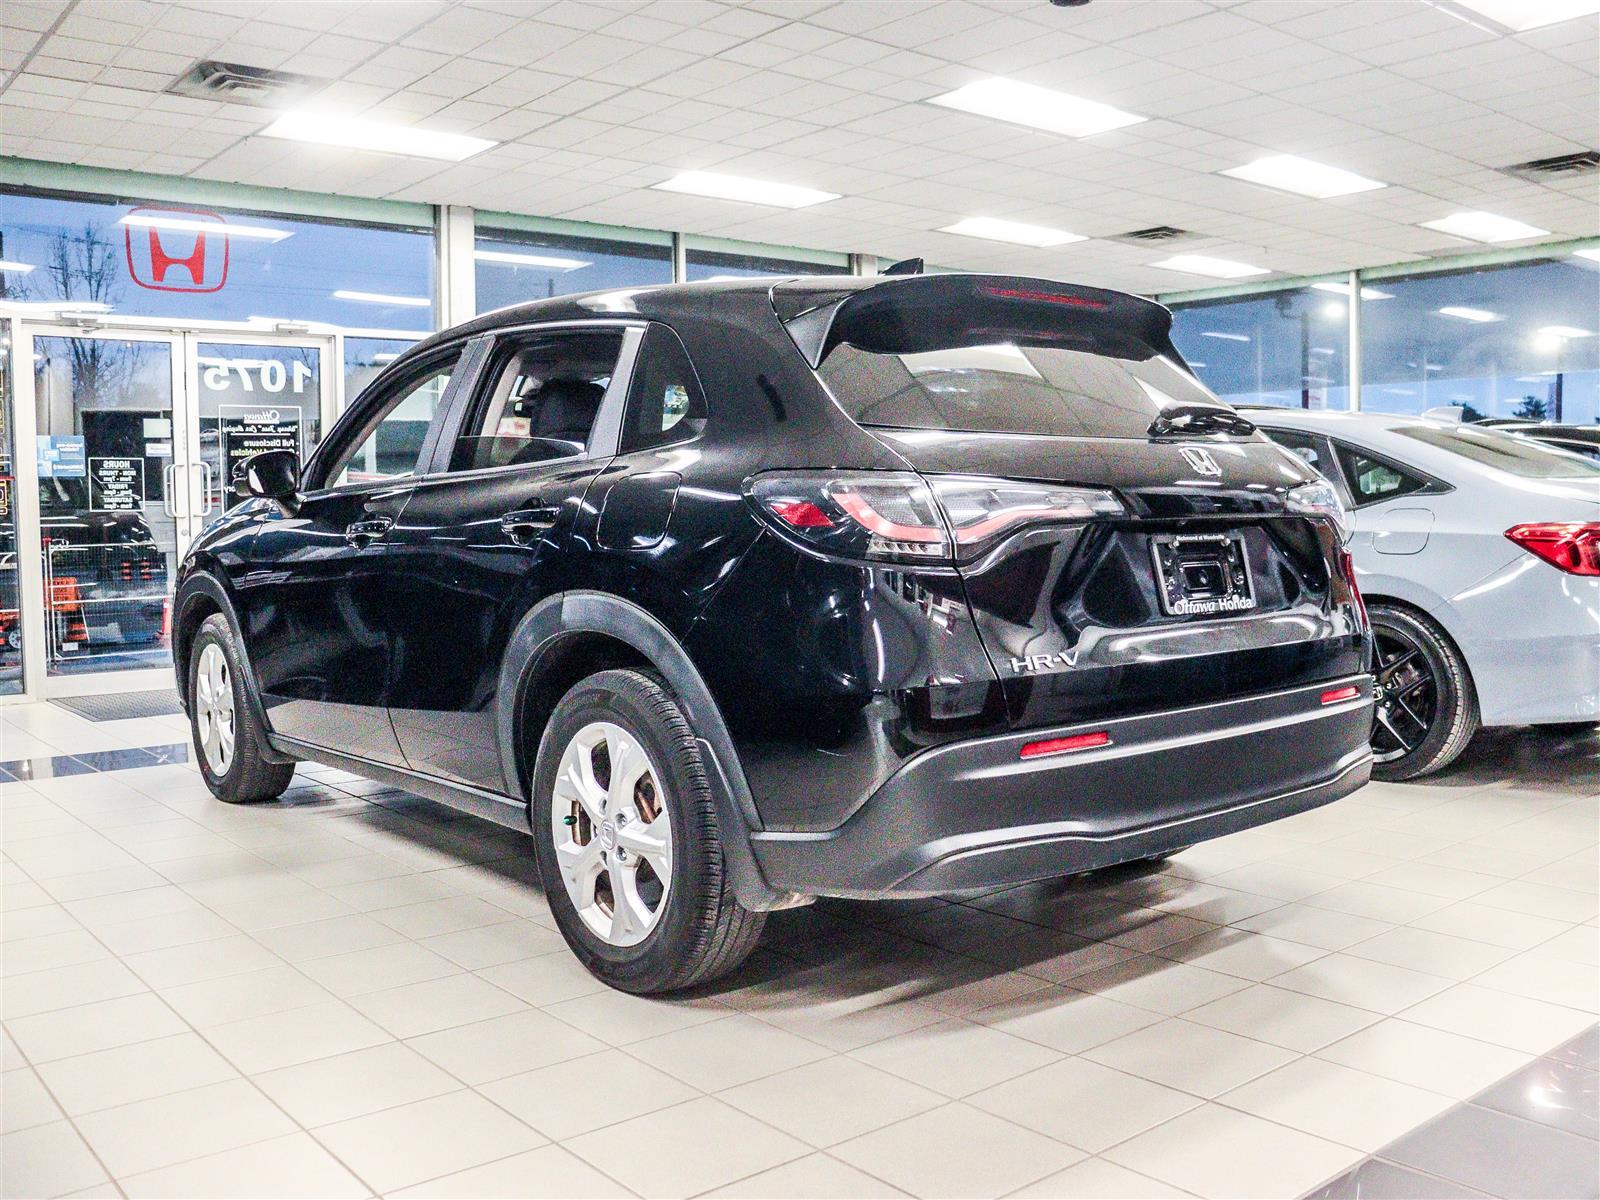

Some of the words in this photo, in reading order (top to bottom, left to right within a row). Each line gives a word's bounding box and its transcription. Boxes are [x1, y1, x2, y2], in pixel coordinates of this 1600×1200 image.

[1174, 599, 1216, 615] Ottawa
[1219, 596, 1252, 611] Honda
[1010, 650, 1079, 673] HR-V
